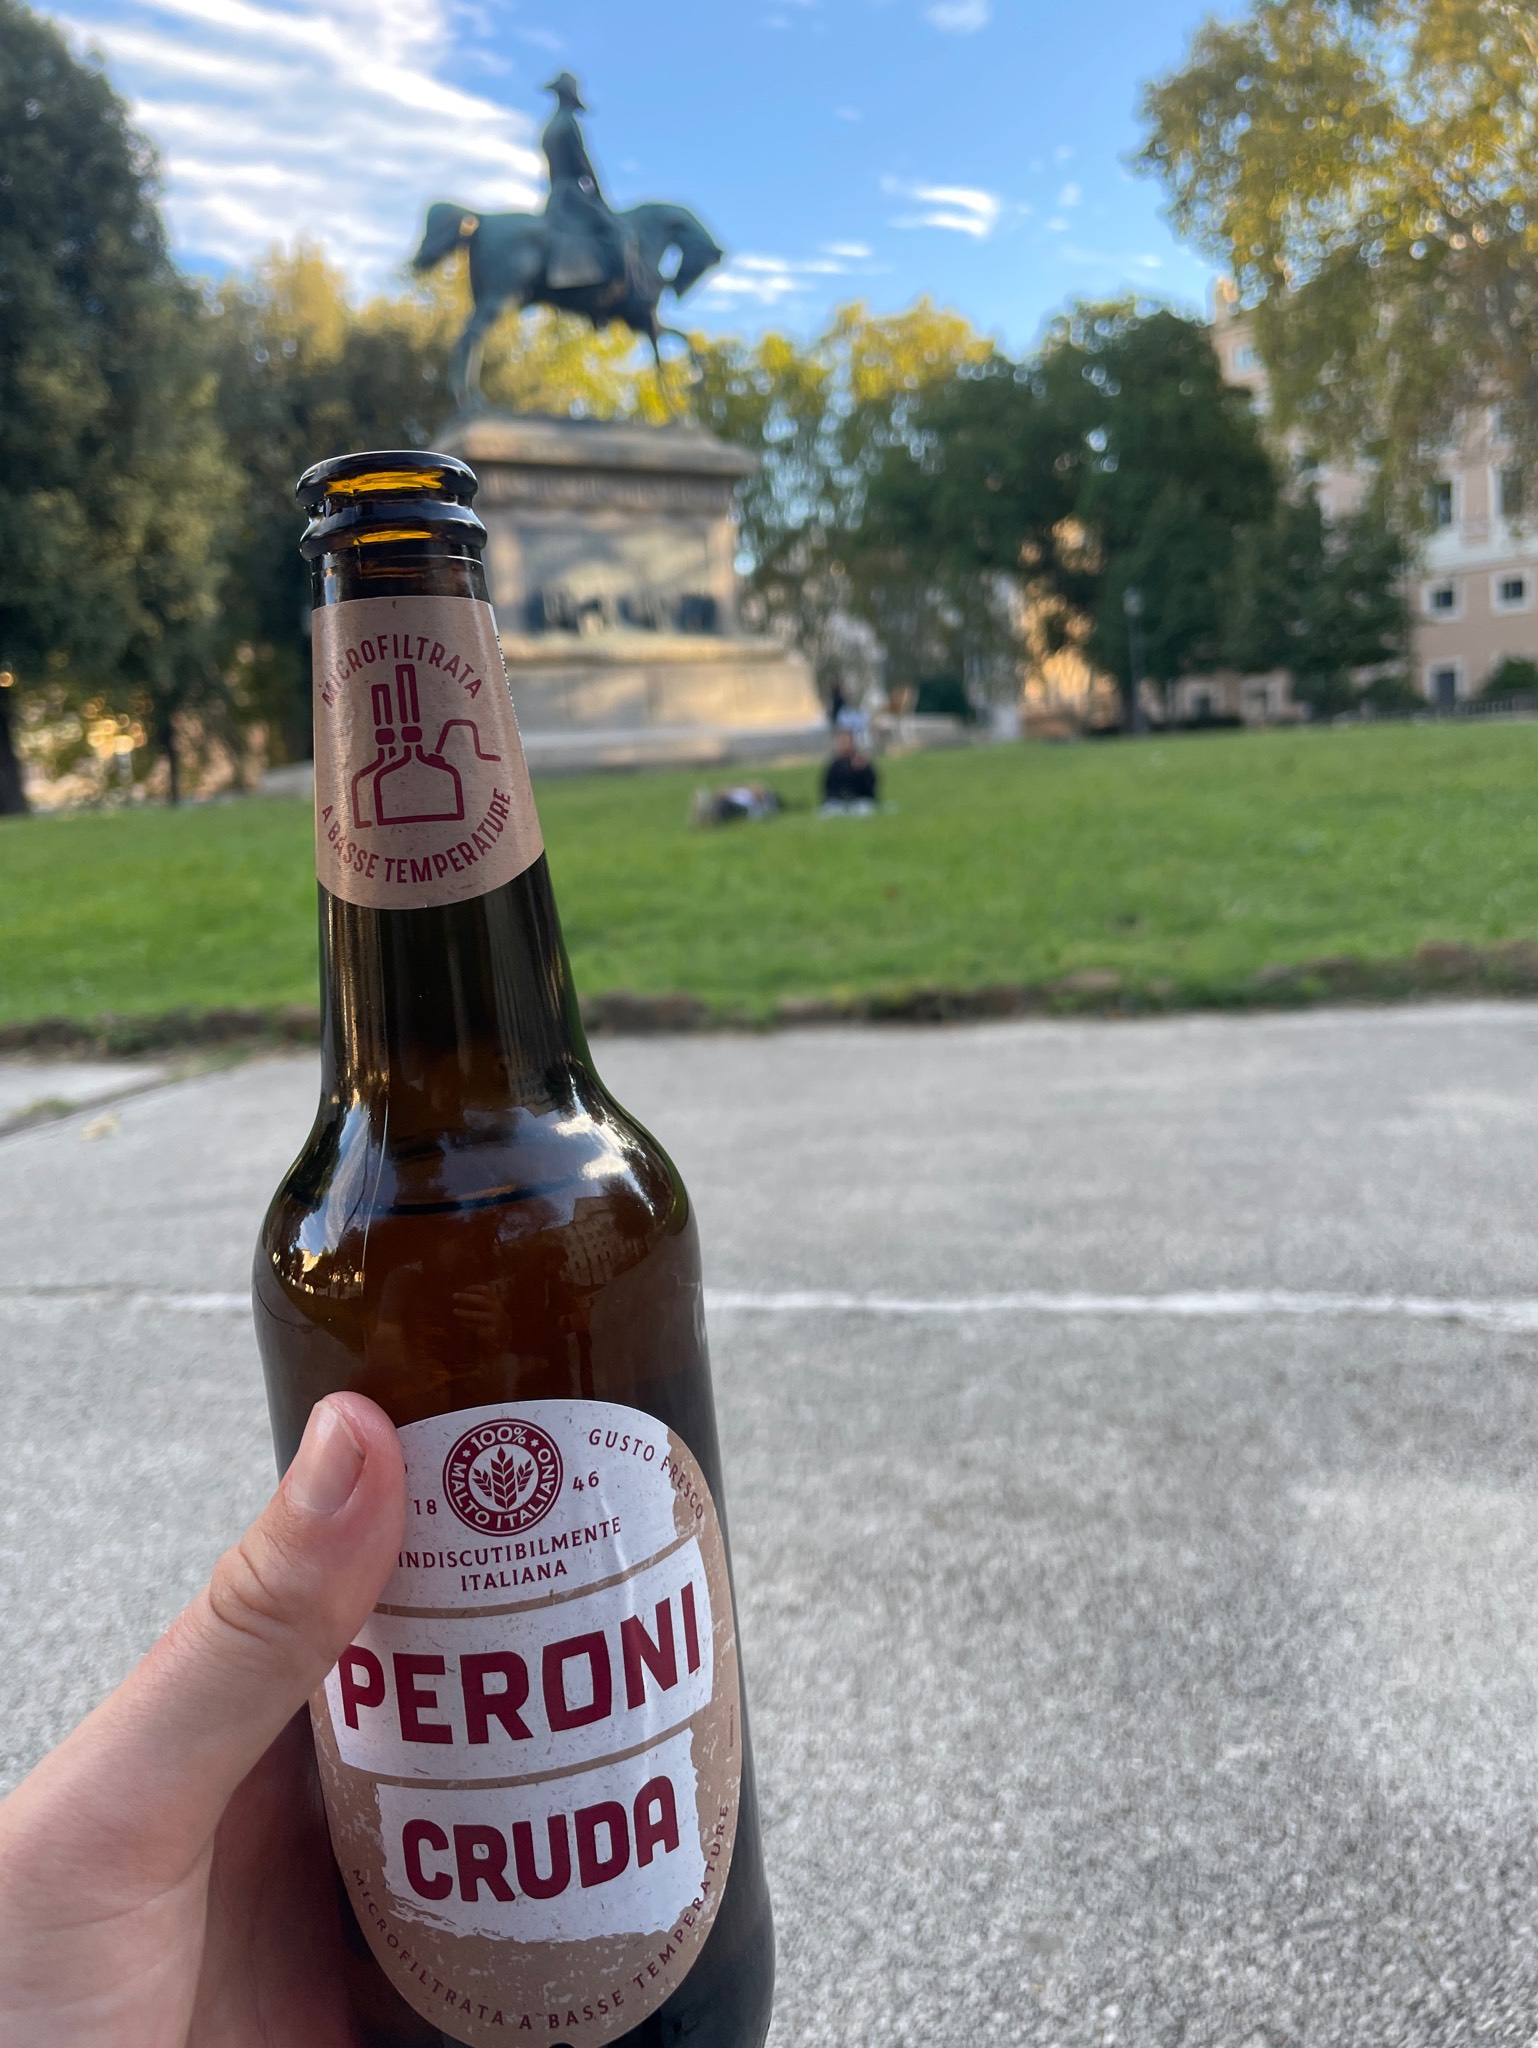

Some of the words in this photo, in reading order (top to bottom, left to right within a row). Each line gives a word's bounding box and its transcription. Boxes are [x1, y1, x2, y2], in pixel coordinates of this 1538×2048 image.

[322, 633, 483, 709] MICROFILTRATA
[321, 804, 334, 823] A
[327, 820, 380, 879] BASSE
[384, 787, 511, 884] TEMPERATURE
[470, 1425, 528, 1451] 100%
[588, 1428, 656, 1462] GUSTO
[660, 1457, 704, 1520] FRESCO
[413, 1499, 438, 1516] 18
[572, 1470, 600, 1493] 46
[450, 1461, 491, 1526] MALTO
[496, 1447, 556, 1529] ITALIANO
[398, 1516, 622, 1569] INDISCUTIBILMENTE
[460, 1559, 568, 1592] ITALIANA
[338, 1581, 702, 1745] PERONI
[401, 1775, 680, 1903] CRUDA
[352, 1868, 505, 2027] MICROFILTRATA
[518, 2014, 533, 2030] A
[548, 1989, 625, 2030] BASSE
[632, 1805, 730, 1990] TEMPERATURE
